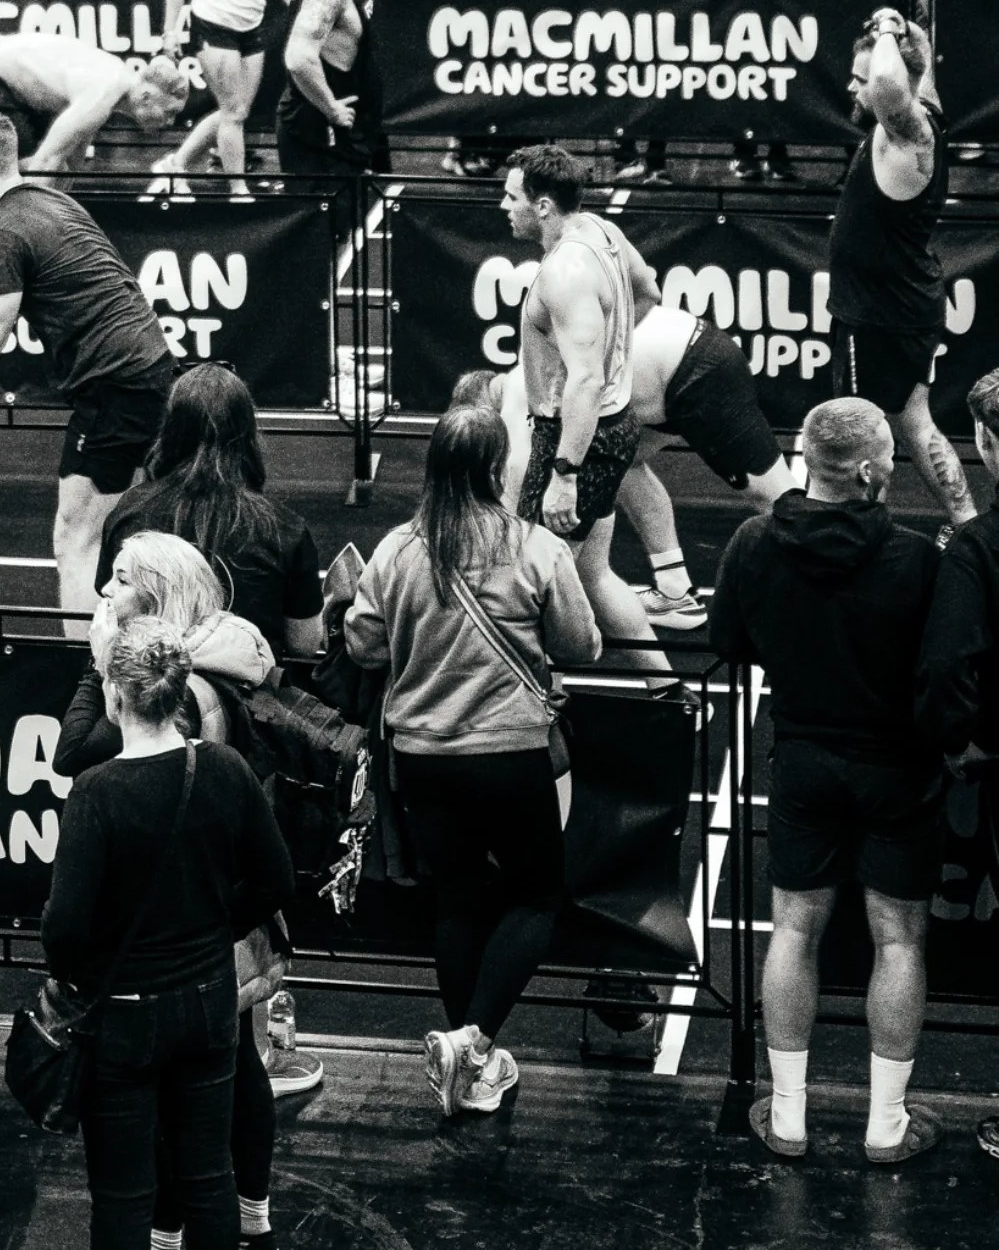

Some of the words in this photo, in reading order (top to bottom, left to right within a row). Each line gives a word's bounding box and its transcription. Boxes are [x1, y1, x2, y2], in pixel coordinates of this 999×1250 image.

[428, 7, 818, 63] MACMILLAN
[434, 60, 597, 97] CANCER
[606, 64, 796, 101] SUPPORT
